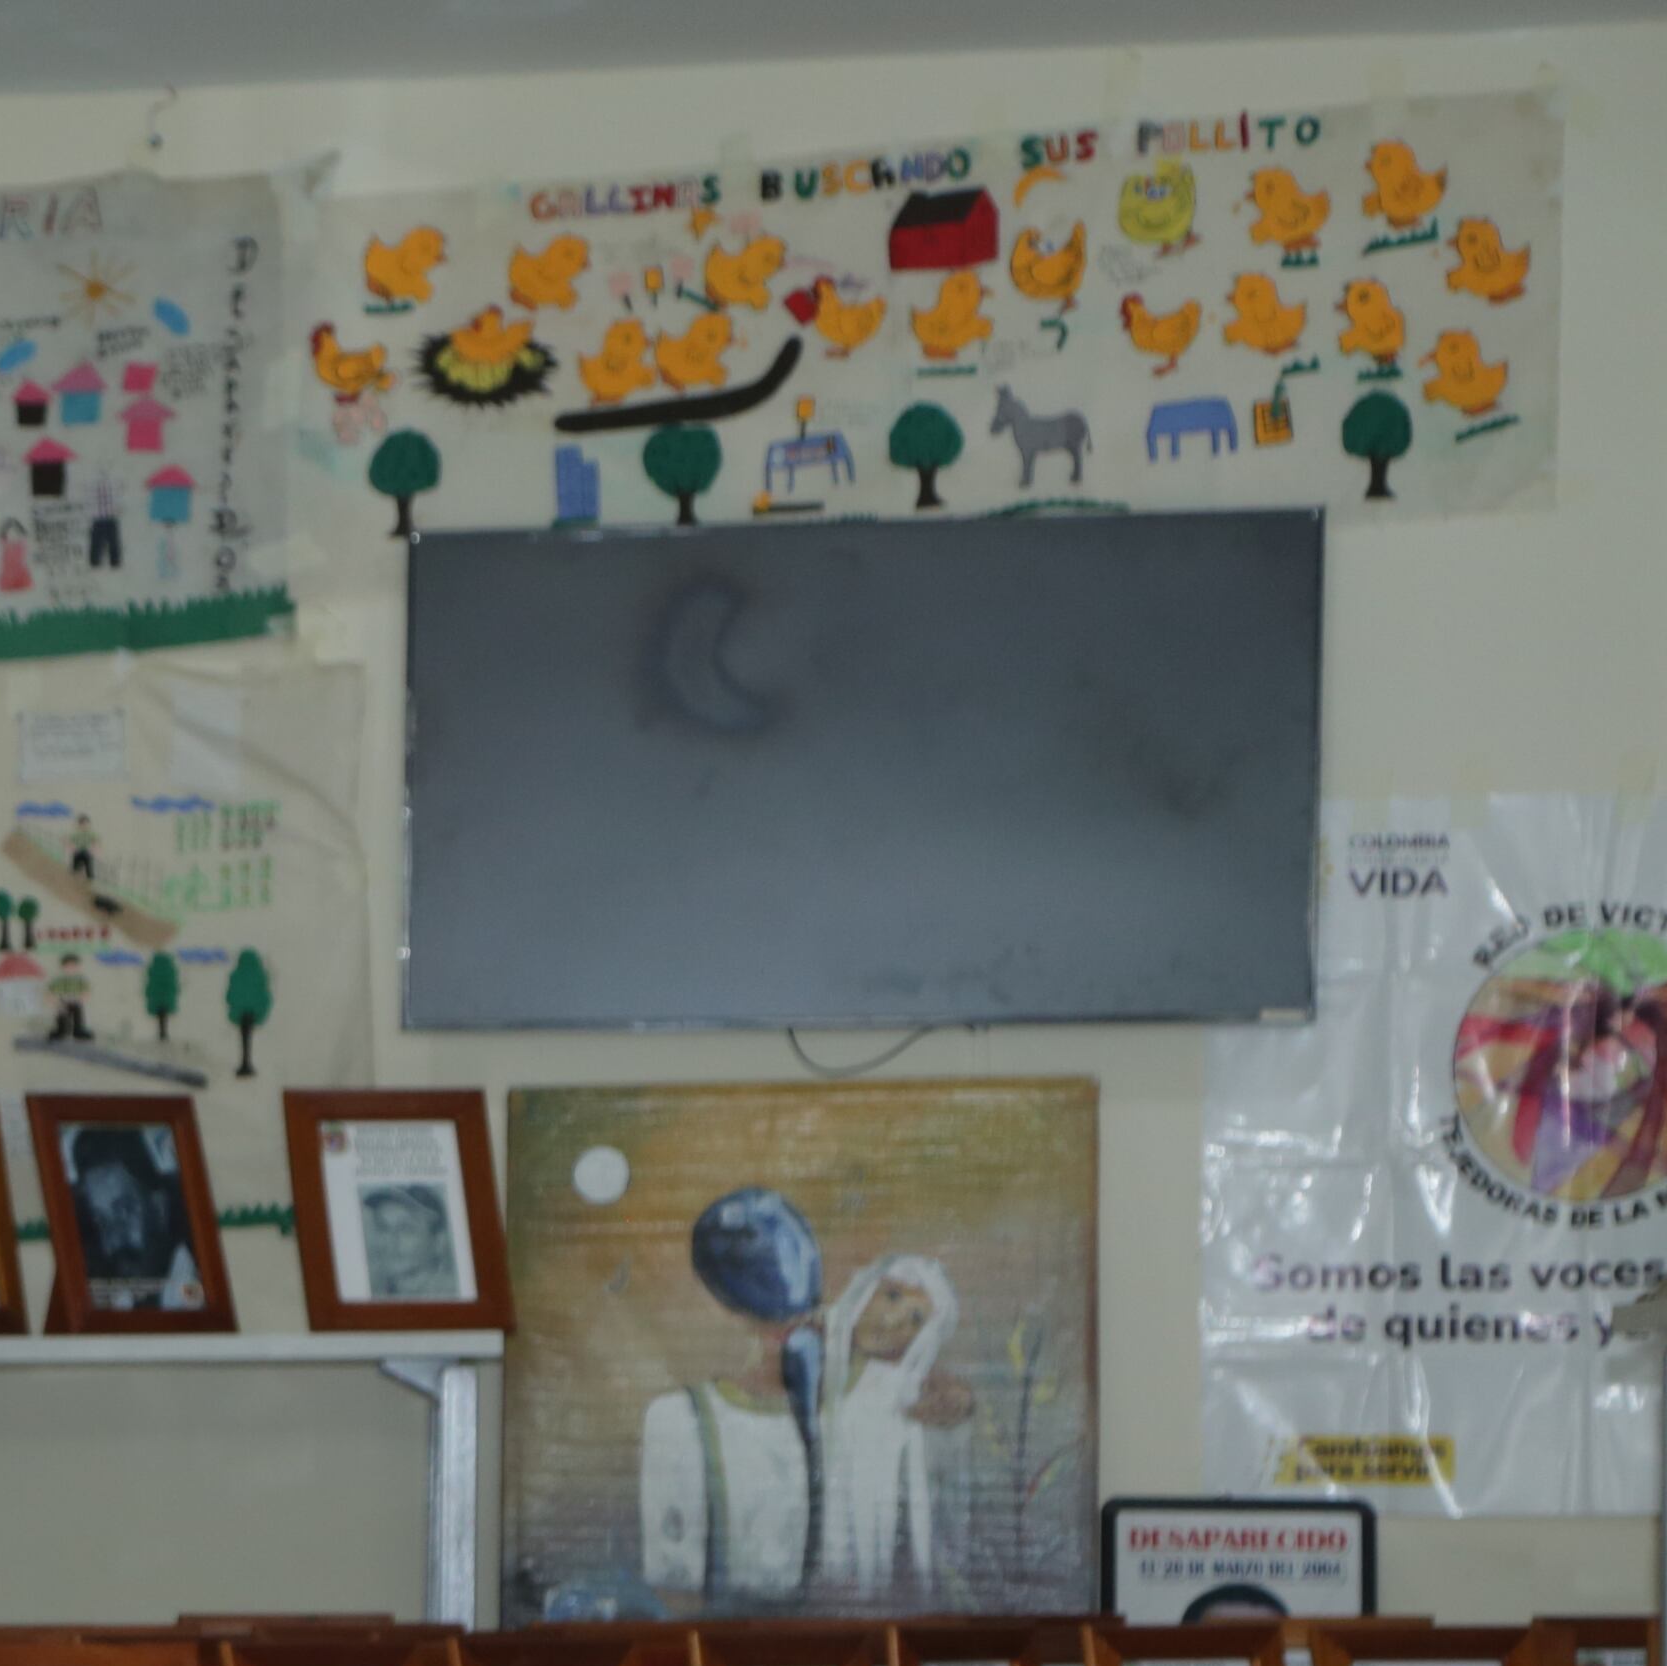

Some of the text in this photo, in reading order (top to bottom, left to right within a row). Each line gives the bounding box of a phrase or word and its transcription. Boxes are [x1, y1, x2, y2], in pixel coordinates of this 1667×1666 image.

[1019, 129, 1099, 169] SUS
[1349, 866, 1449, 898] VIDA
[1543, 903, 1585, 928] DE
[1570, 1208, 1604, 1228] DE
[1614, 1201, 1649, 1223] LA
[1253, 1253, 1421, 1292] Somos
[1439, 1252, 1512, 1291] las
[1308, 1303, 1366, 1343] de
[1384, 1301, 1579, 1348] quienes
[1129, 1526, 1348, 1552] DESAPARECIDO
